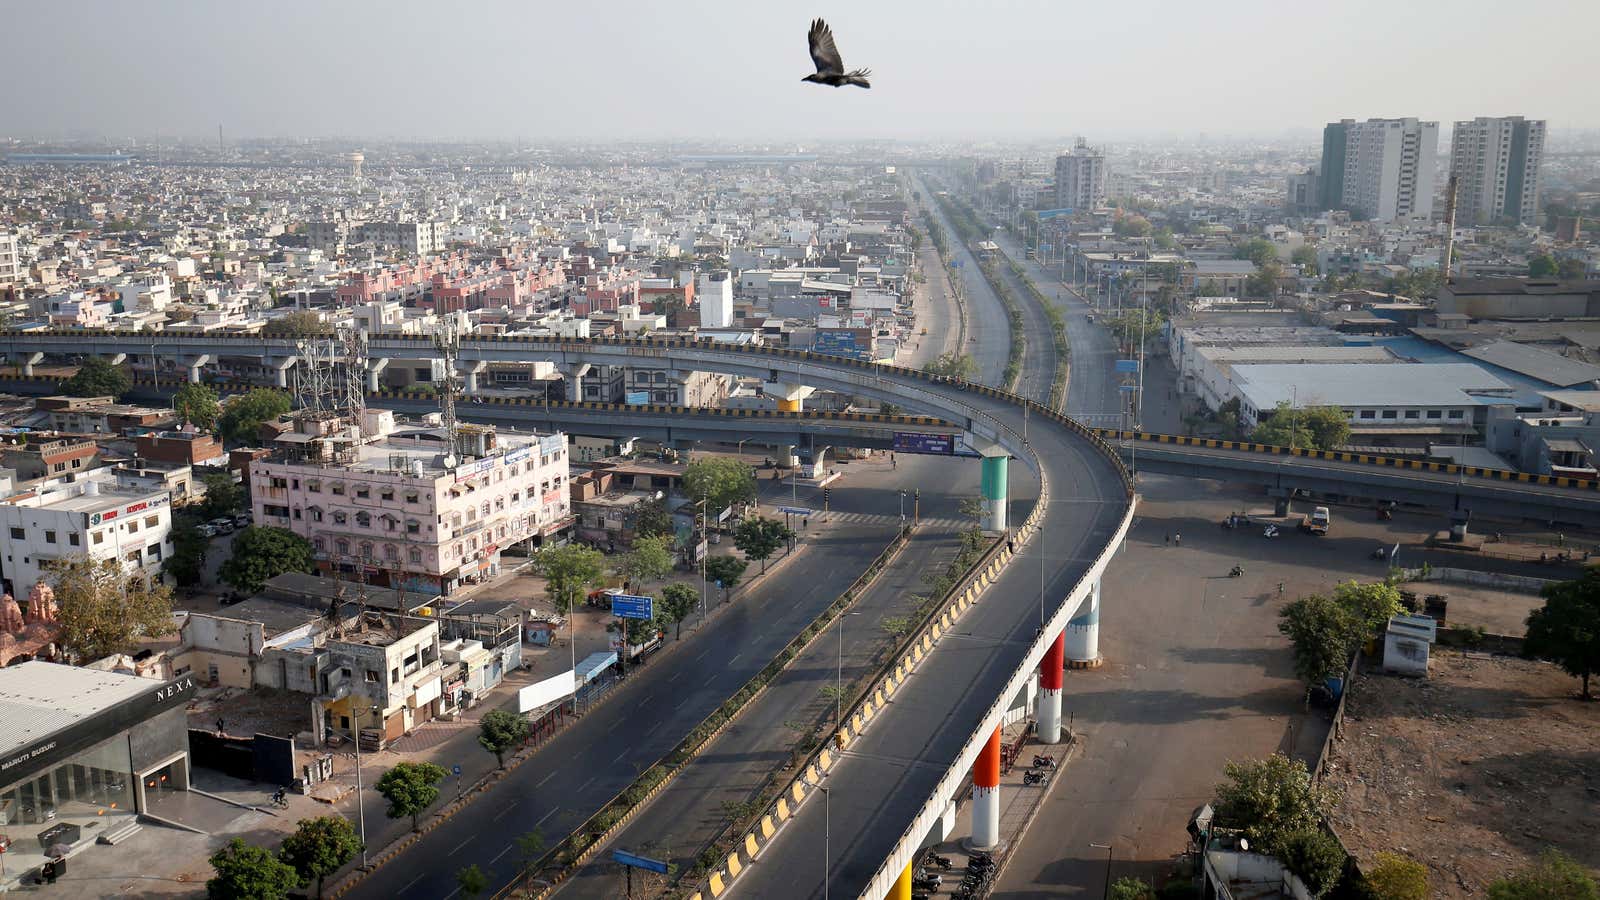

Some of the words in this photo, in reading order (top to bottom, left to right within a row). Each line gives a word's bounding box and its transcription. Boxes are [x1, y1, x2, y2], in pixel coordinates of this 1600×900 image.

[157, 678, 192, 702] NEXA
[1, 753, 30, 770] MARUTI
[32, 741, 56, 757] SUZUKI
